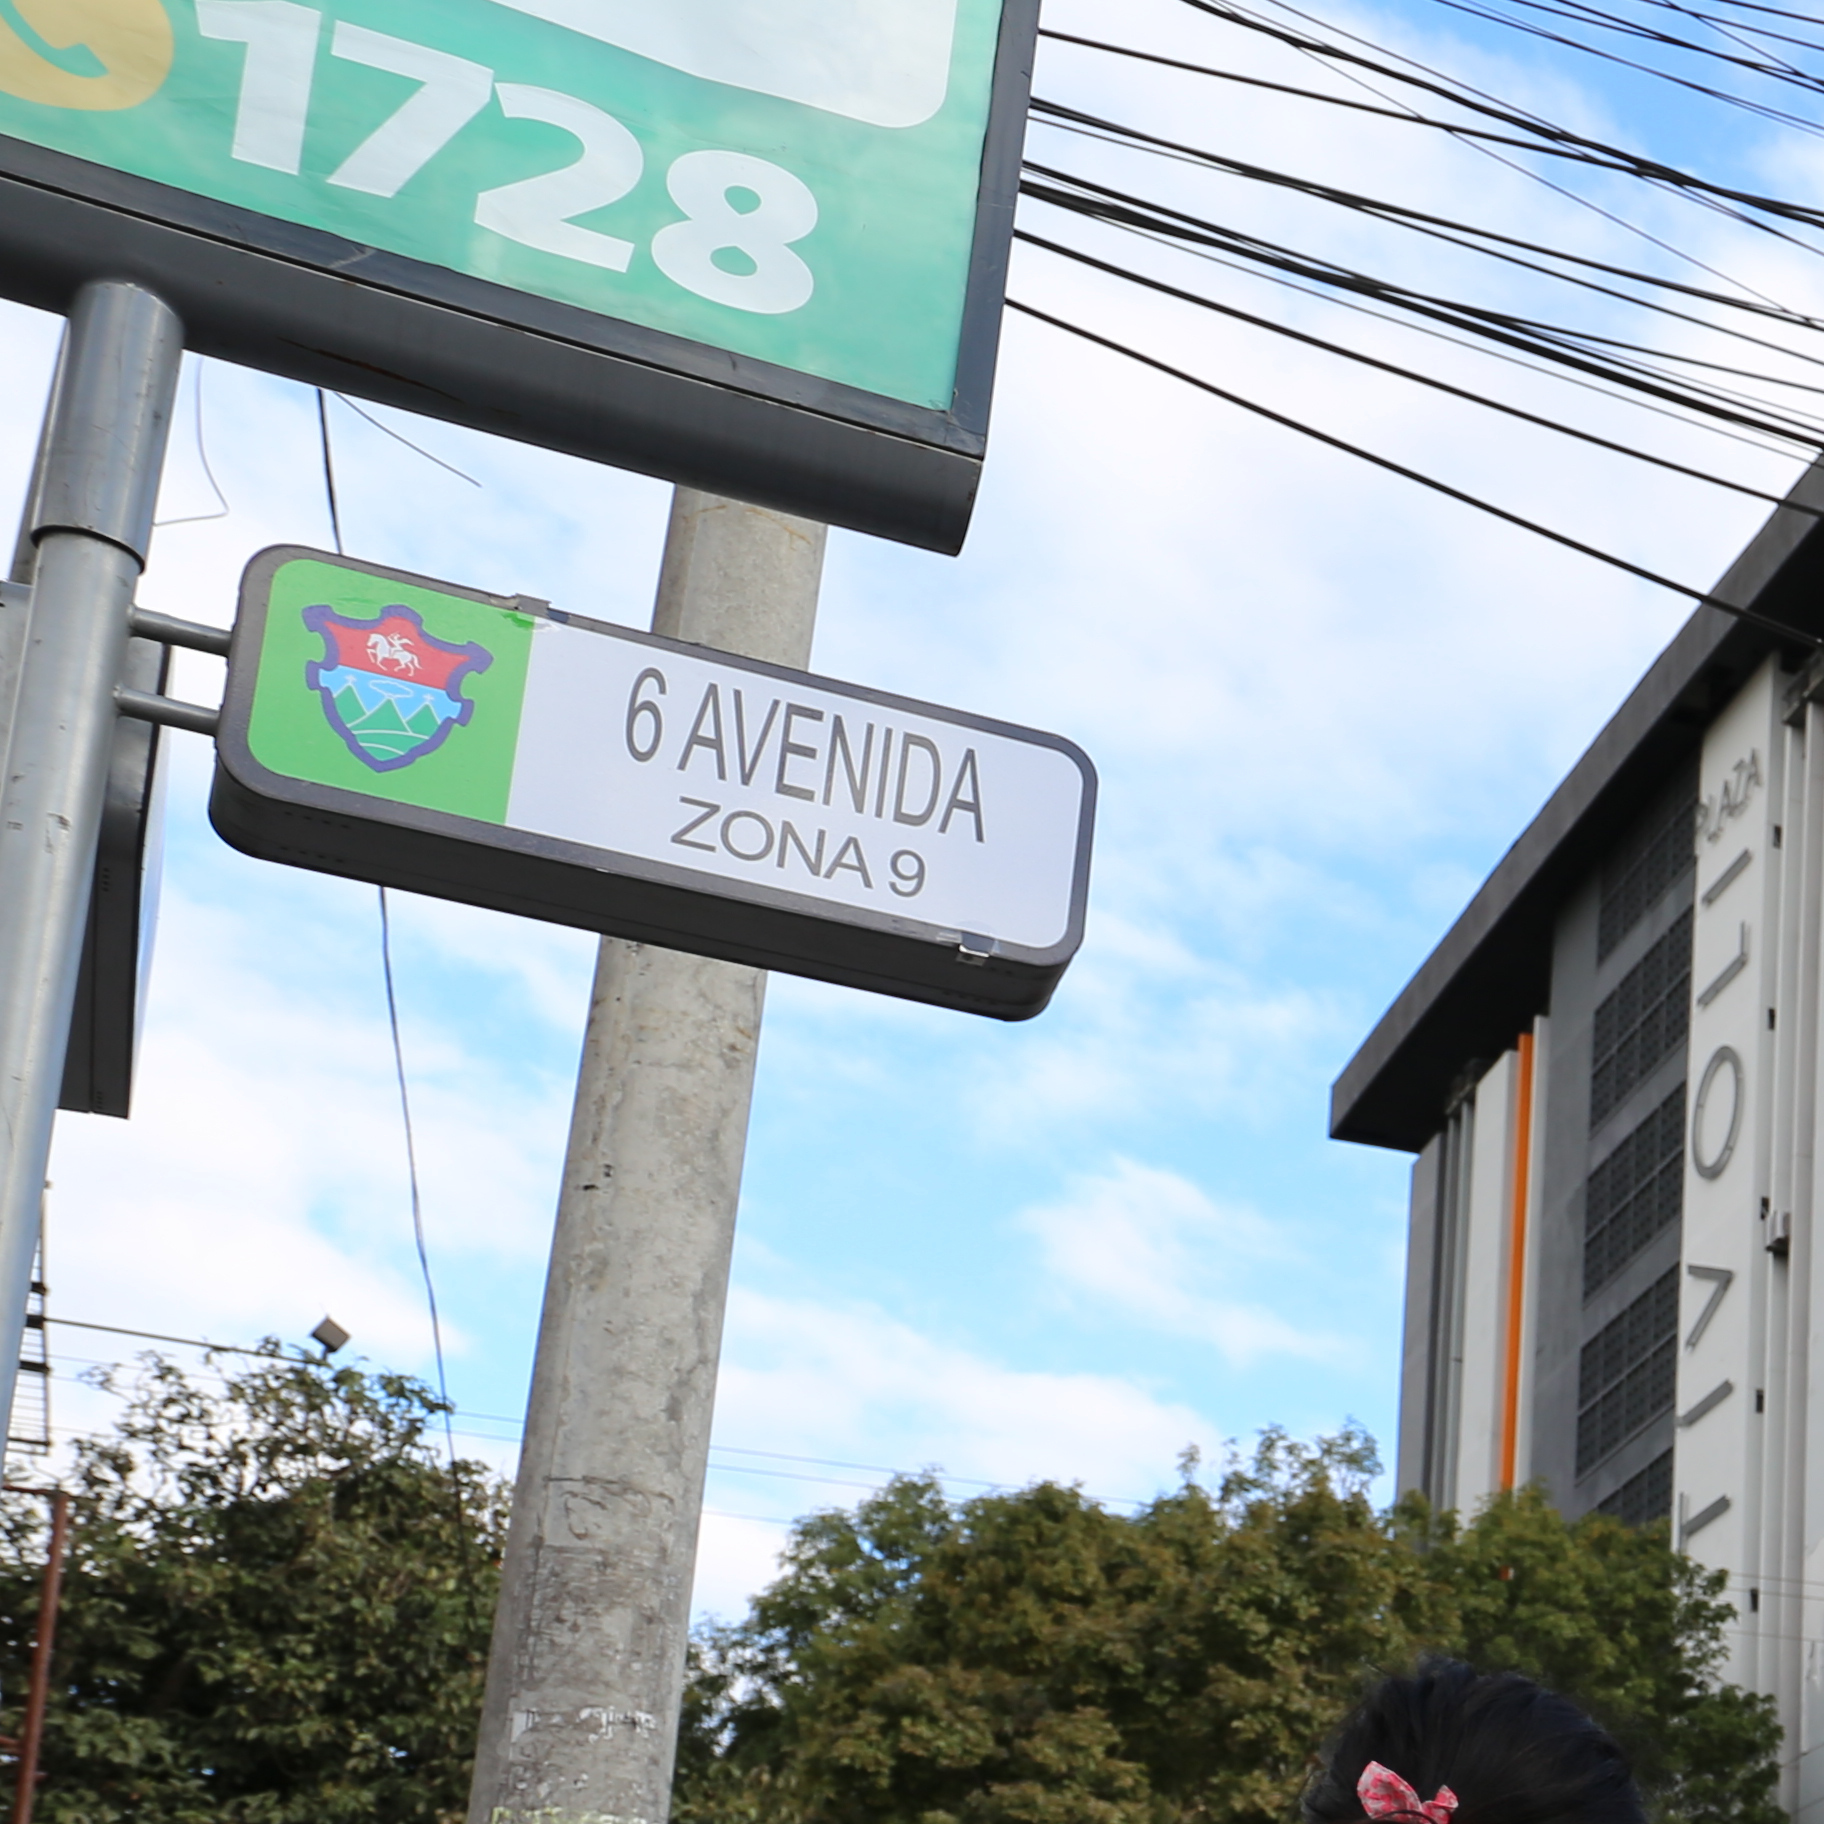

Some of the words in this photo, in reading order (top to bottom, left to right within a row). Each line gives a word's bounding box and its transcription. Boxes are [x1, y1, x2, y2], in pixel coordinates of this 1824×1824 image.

[195, 0, 819, 315] 1728
[625, 667, 667, 763] 6
[676, 682, 985, 843] AVENIDA
[670, 796, 873, 889] ZONA
[888, 849, 926, 898] 9
